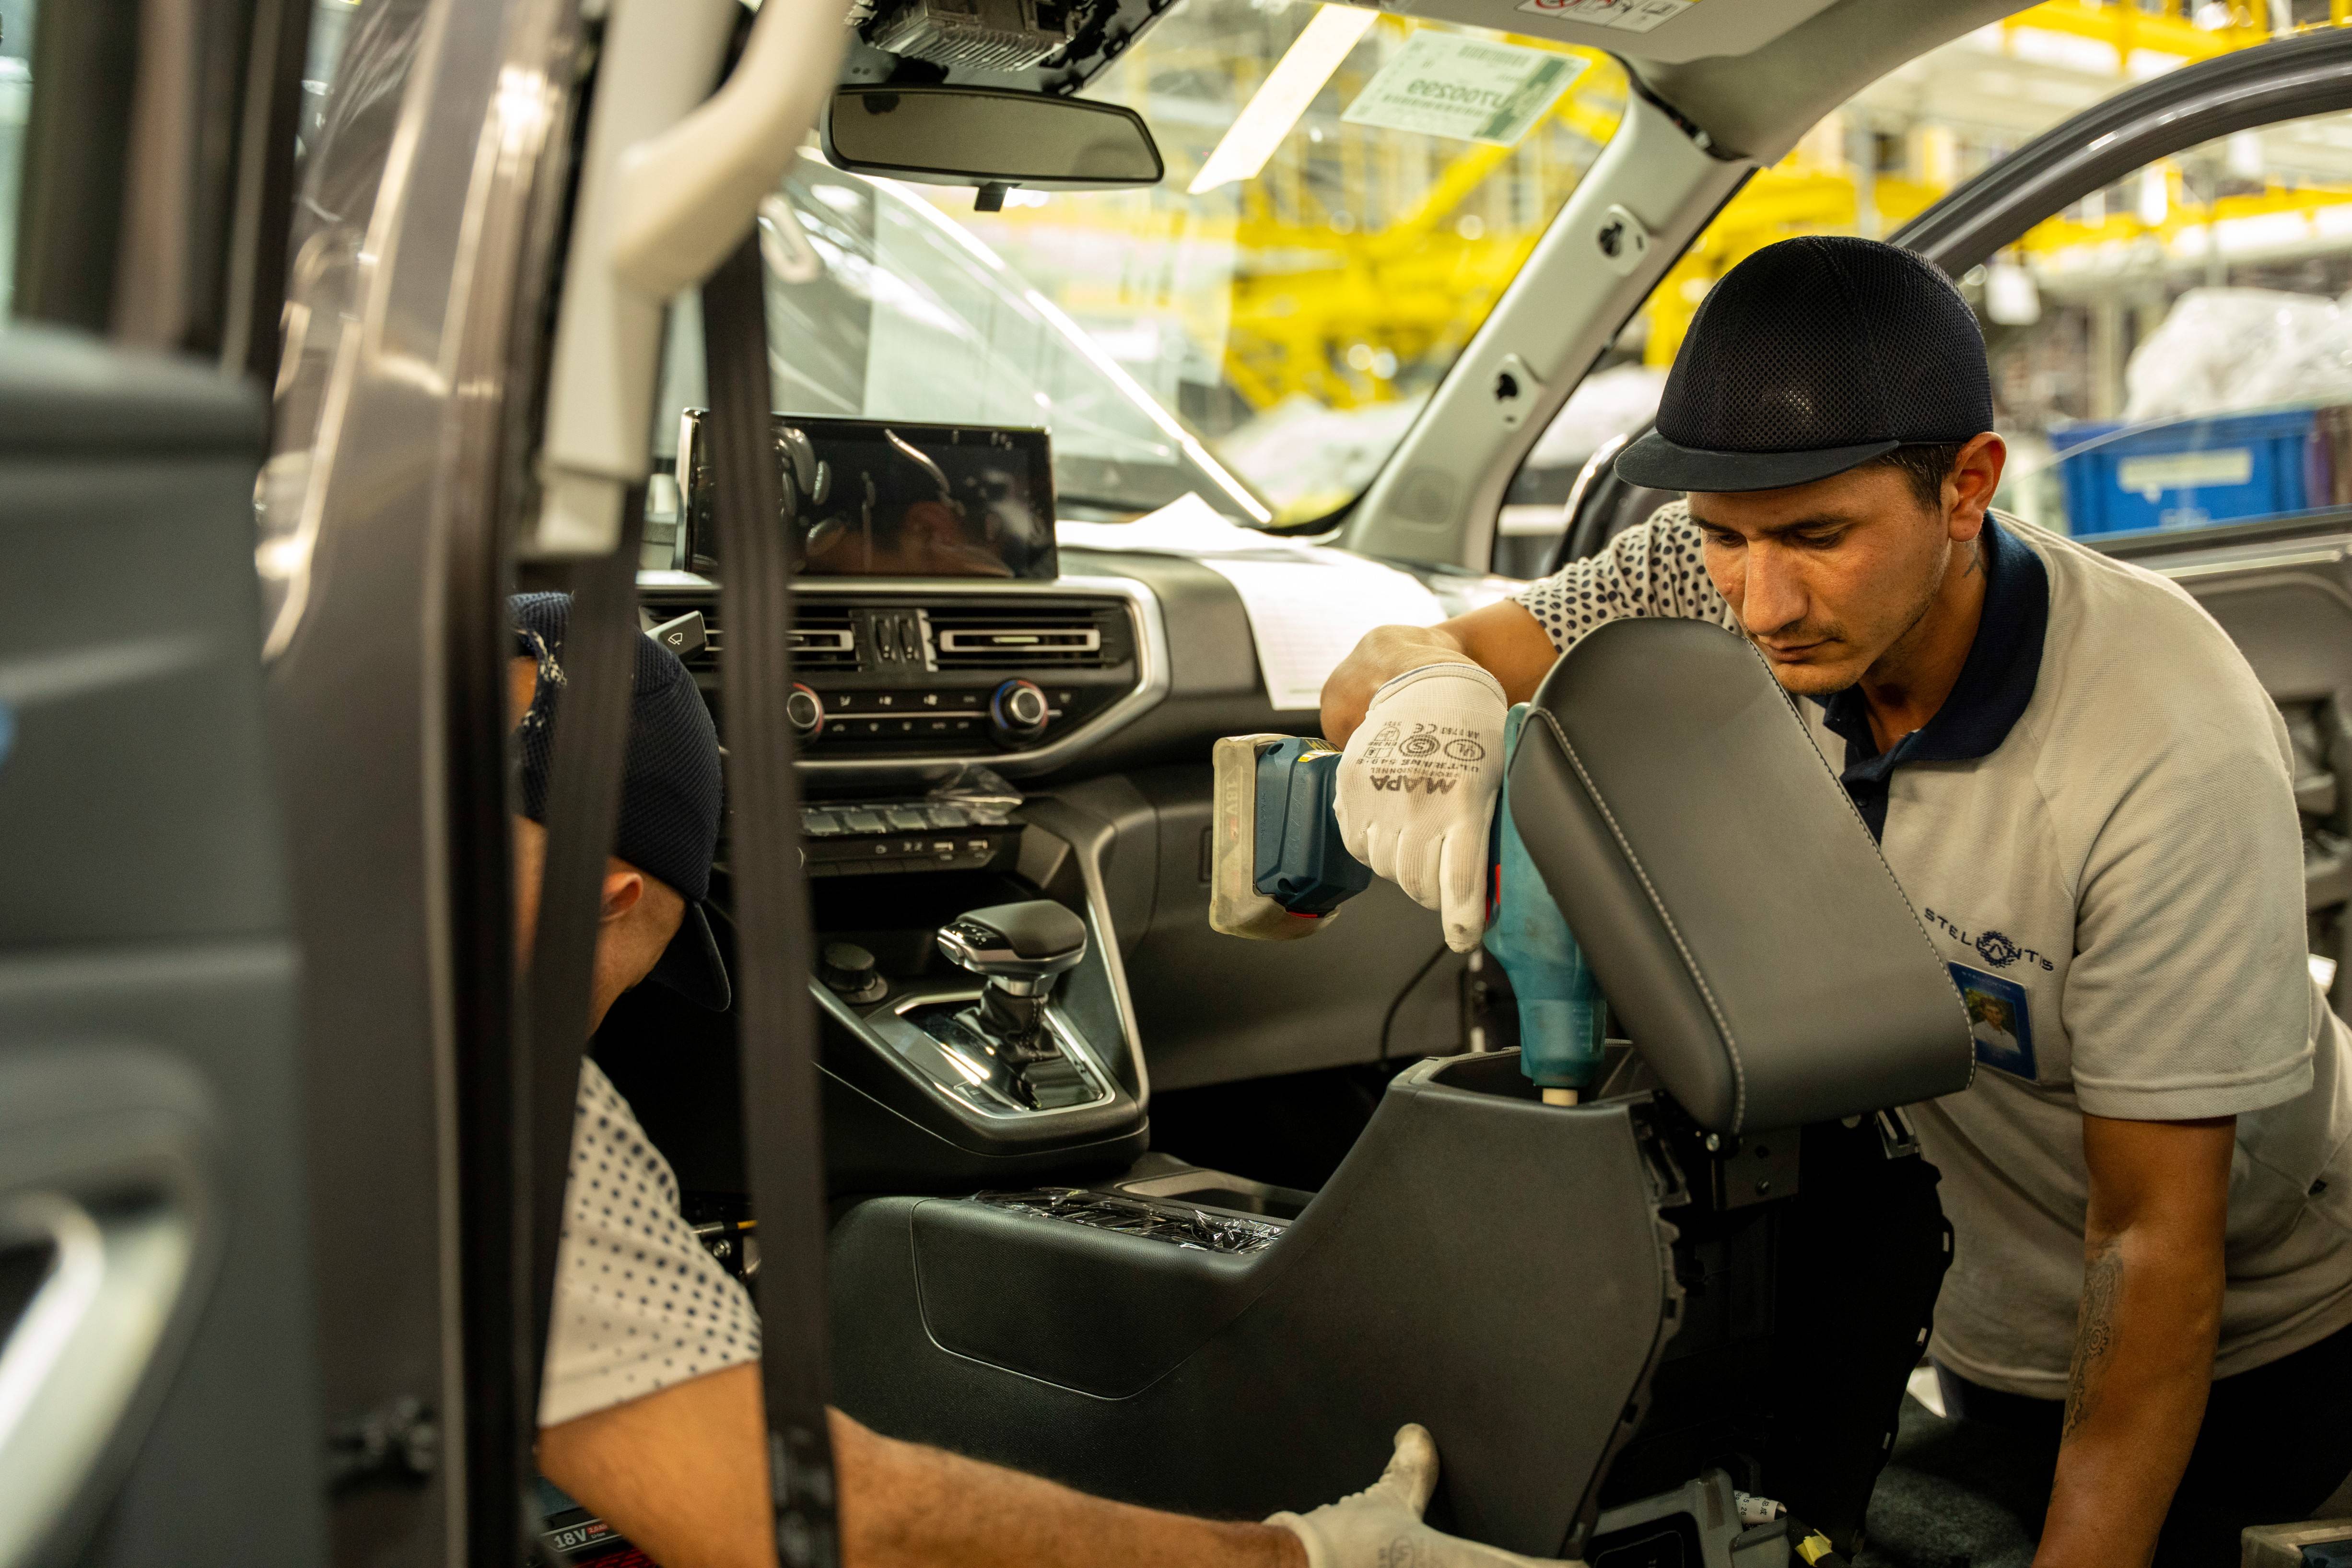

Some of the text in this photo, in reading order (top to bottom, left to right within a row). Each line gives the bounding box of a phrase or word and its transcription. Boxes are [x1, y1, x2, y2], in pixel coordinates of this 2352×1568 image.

[1401, 759, 1478, 772] ULTRANE
[1370, 775, 1457, 794] MAPA
[1225, 781, 1238, 815] 18V
[1760, 1500, 1769, 1515] 总成
[554, 1528, 586, 1548] 18V
